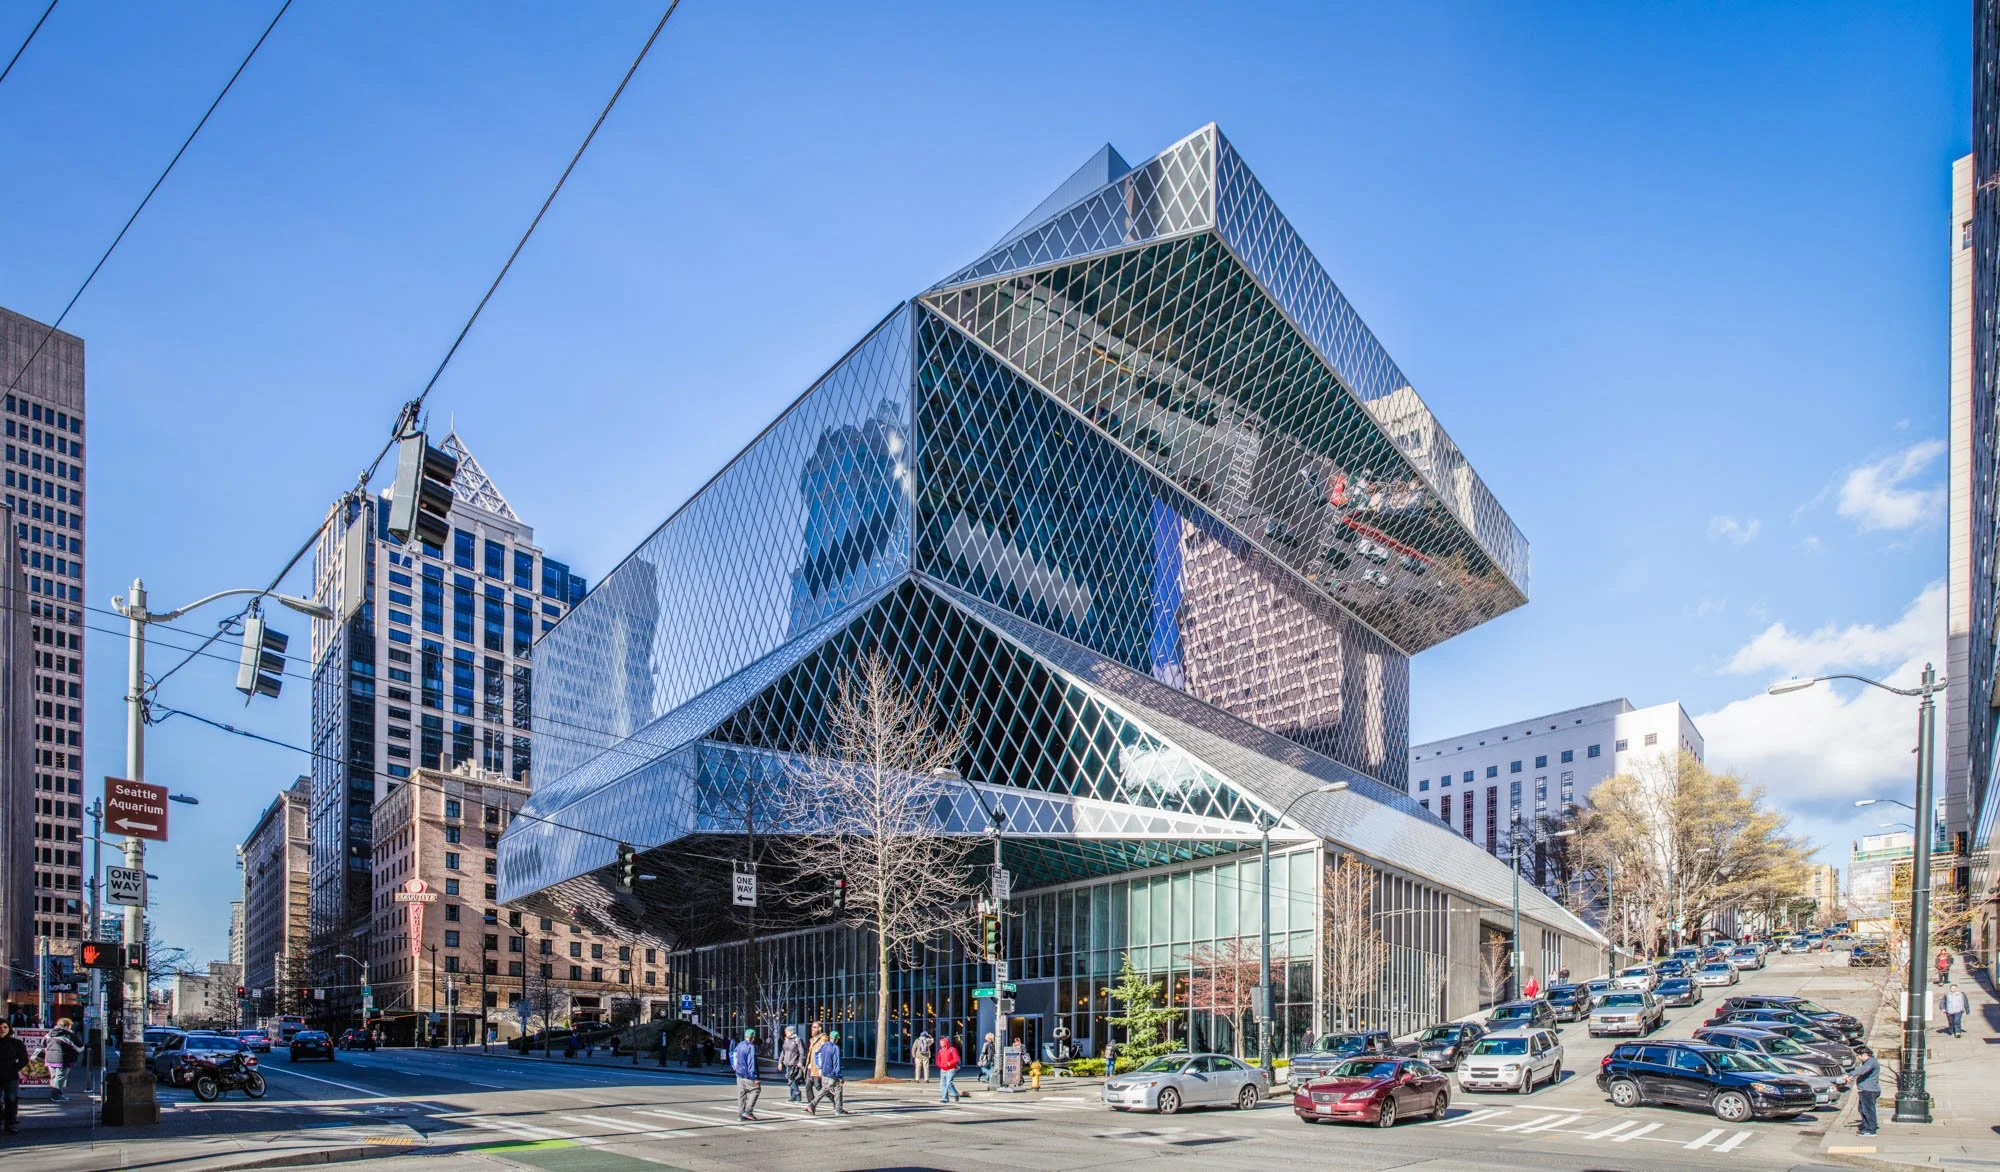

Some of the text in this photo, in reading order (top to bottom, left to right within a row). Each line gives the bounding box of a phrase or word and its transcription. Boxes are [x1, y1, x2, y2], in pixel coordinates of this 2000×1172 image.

[115, 784, 158, 801] Seattle
[108, 797, 164, 816] Aquarium
[111, 869, 141, 882] ONE
[737, 876, 754, 885] ONE
[111, 879, 141, 892] WAY
[737, 885, 753, 893] WAY
